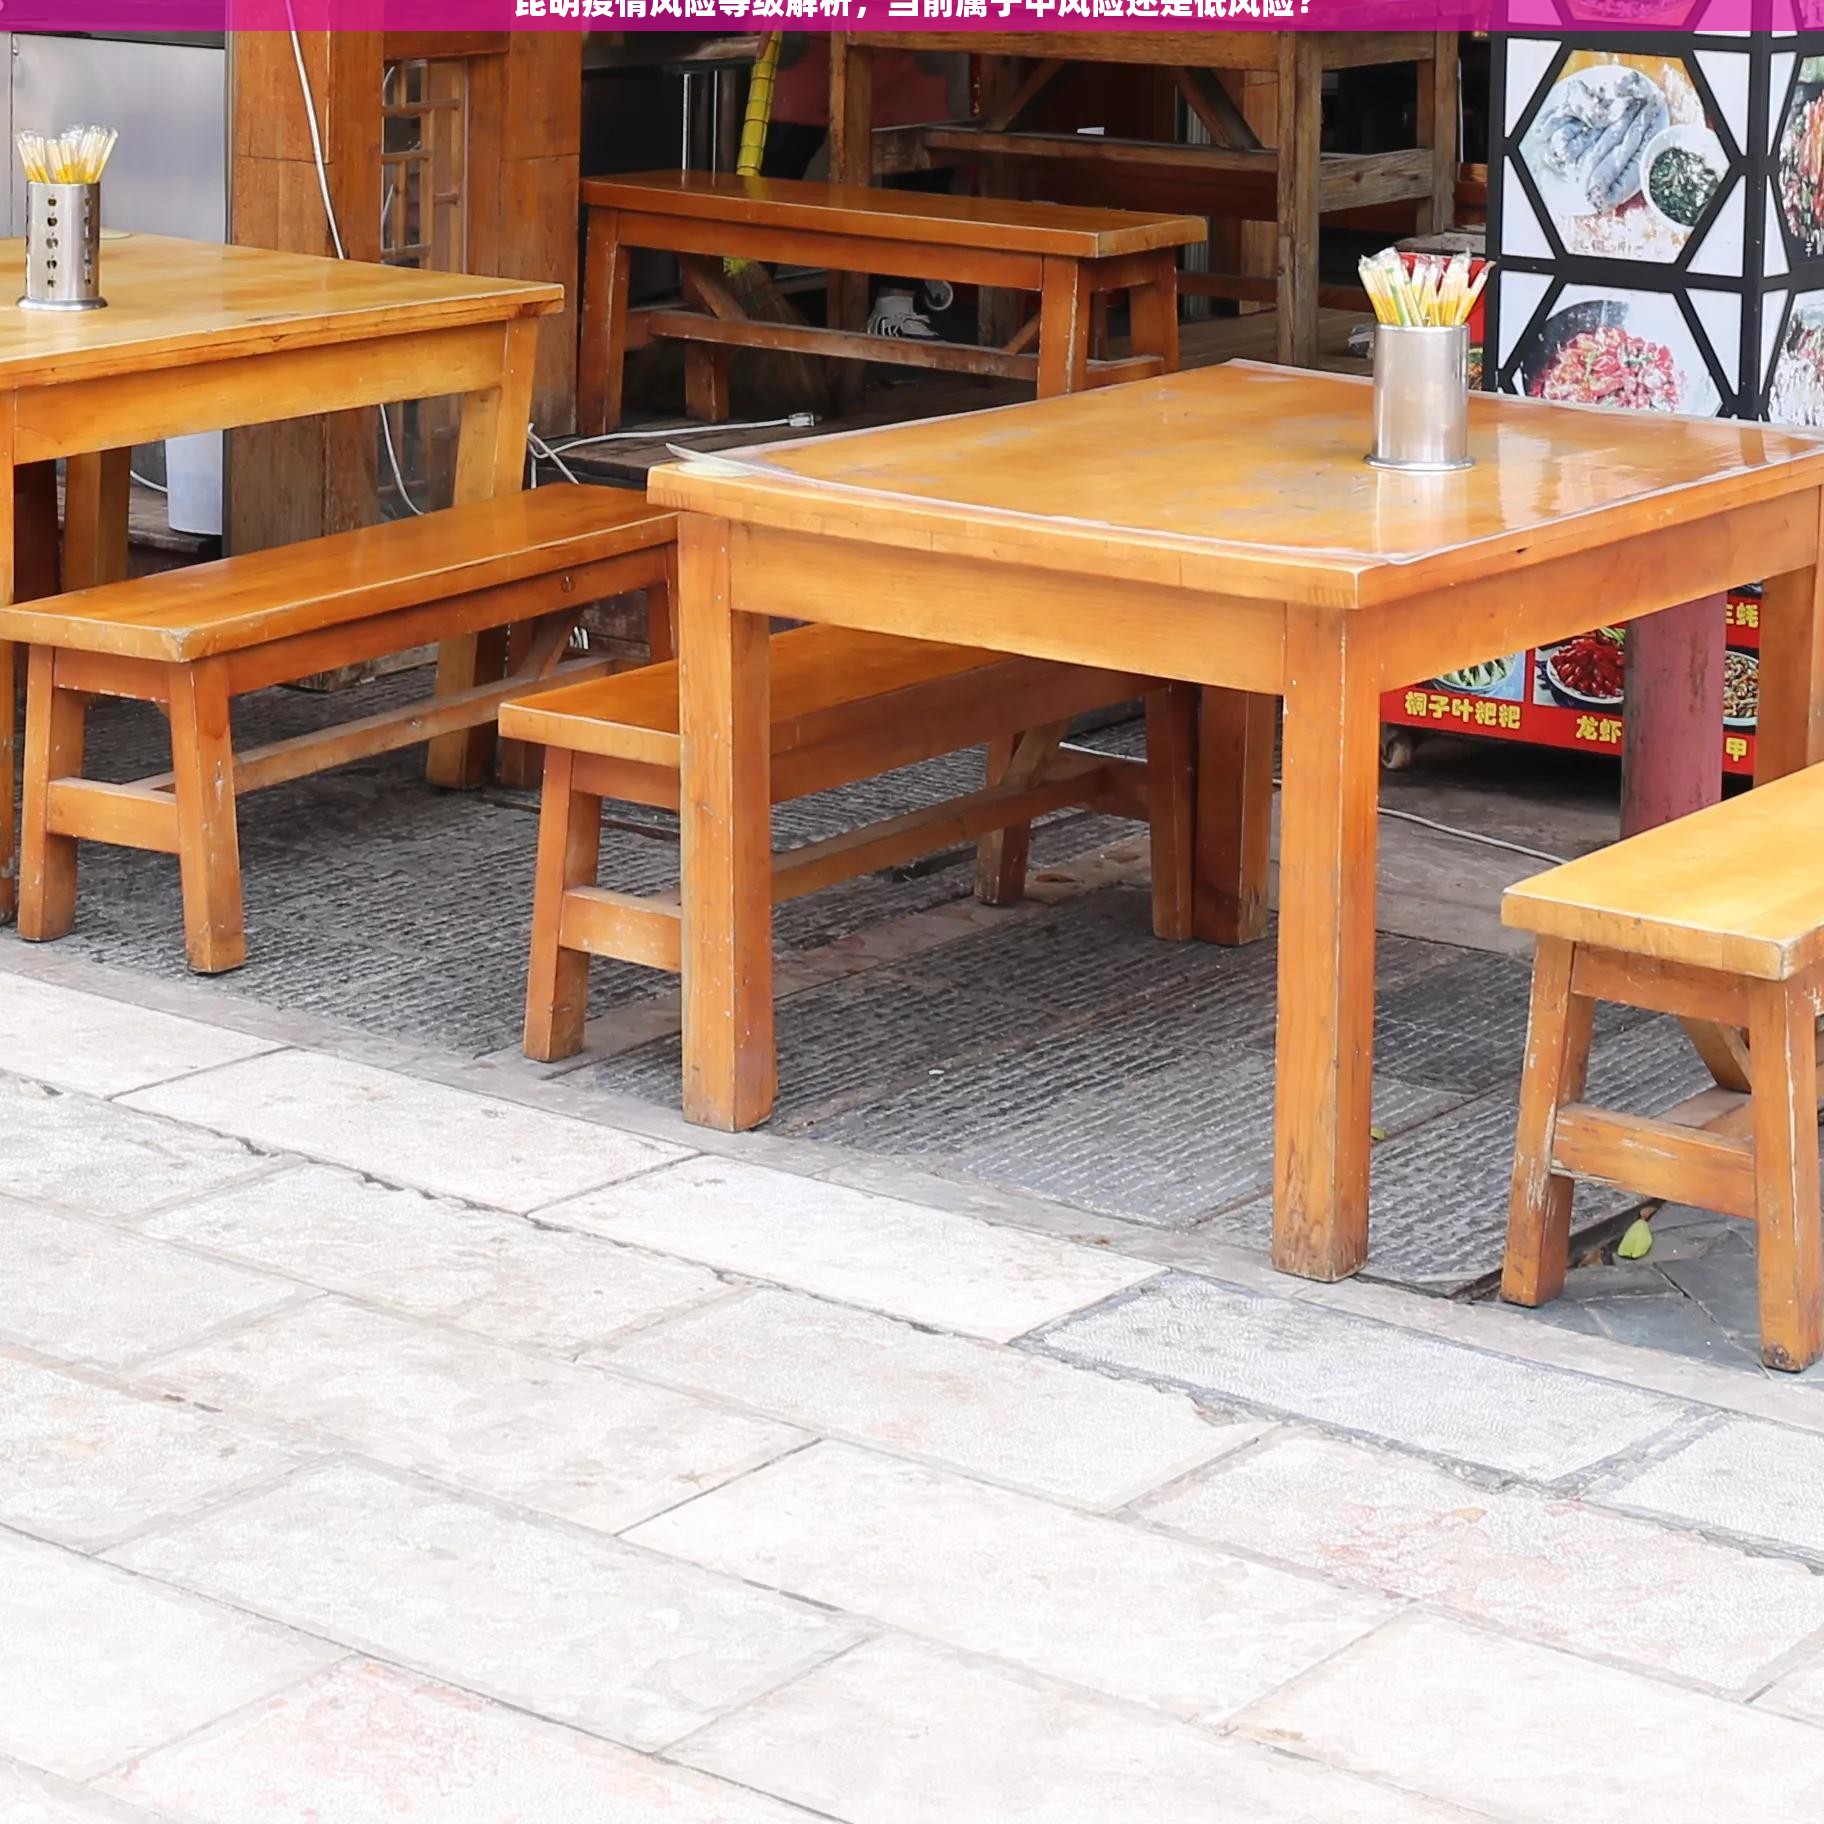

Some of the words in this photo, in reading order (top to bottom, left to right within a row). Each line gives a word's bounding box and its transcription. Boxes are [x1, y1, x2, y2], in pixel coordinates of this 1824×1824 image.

[1404, 691, 1521, 730] 桐子叶粑粑
[1576, 716, 1623, 744] 龙虾
